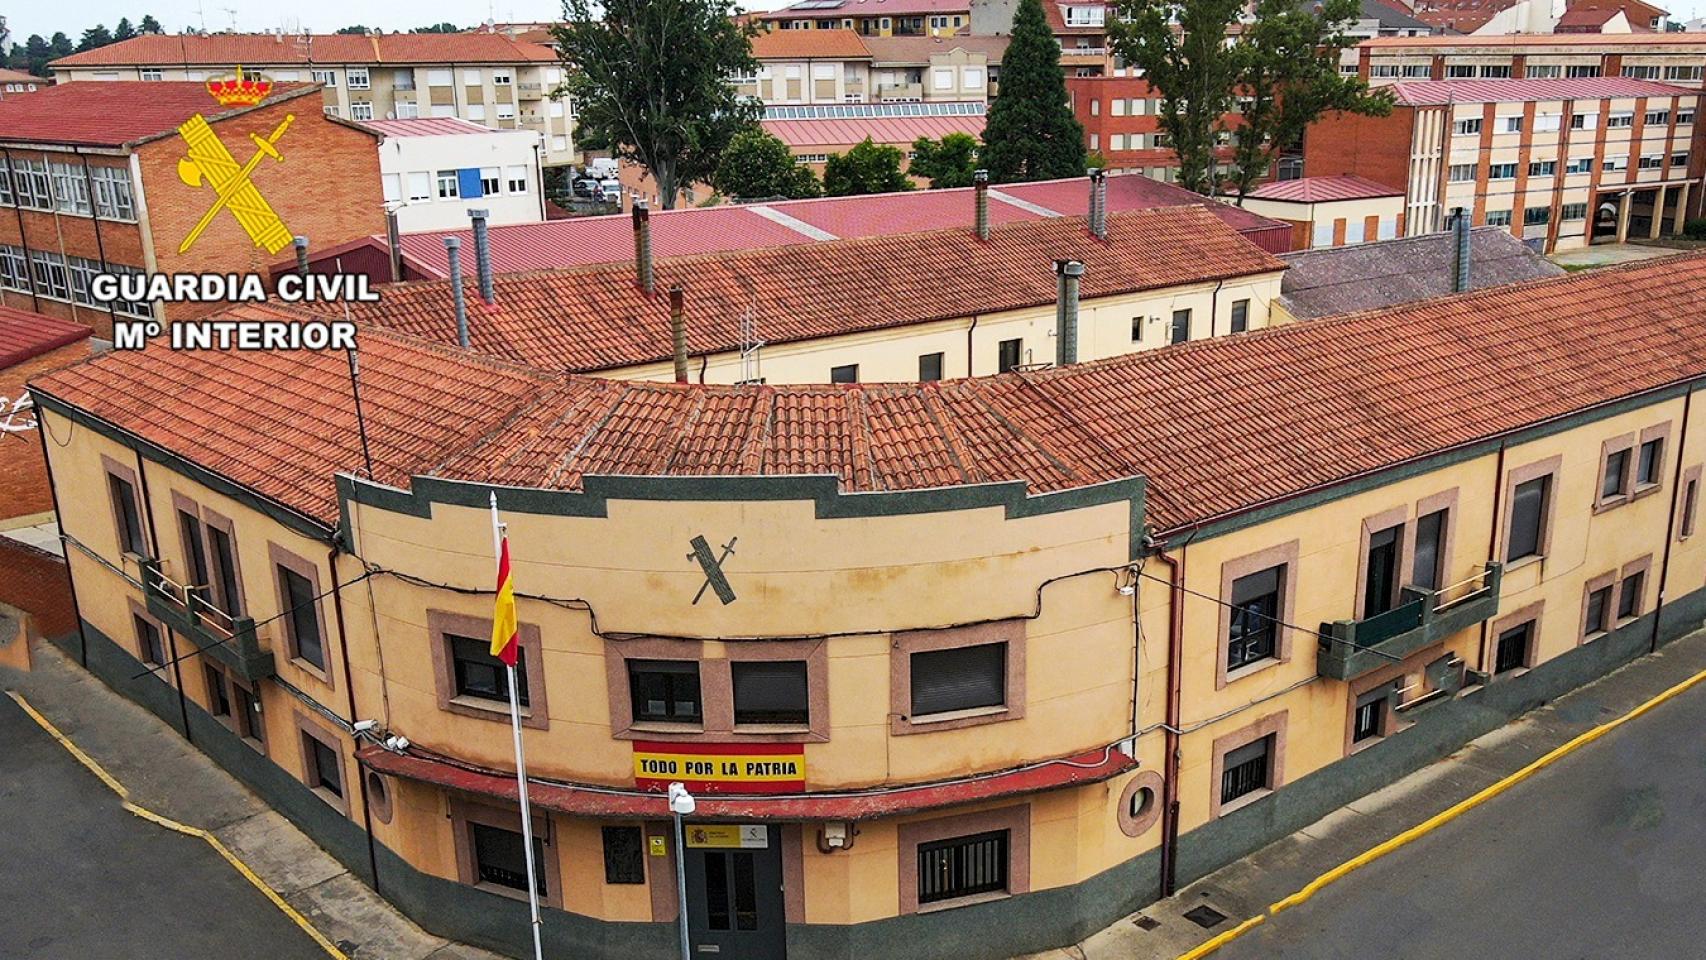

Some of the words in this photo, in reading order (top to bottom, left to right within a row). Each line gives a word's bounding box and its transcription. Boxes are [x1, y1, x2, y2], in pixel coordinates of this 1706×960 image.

[640, 759, 677, 774] TODO
[685, 761, 714, 775] POR
[722, 762, 739, 775] LA
[746, 762, 797, 775] PATRIA
